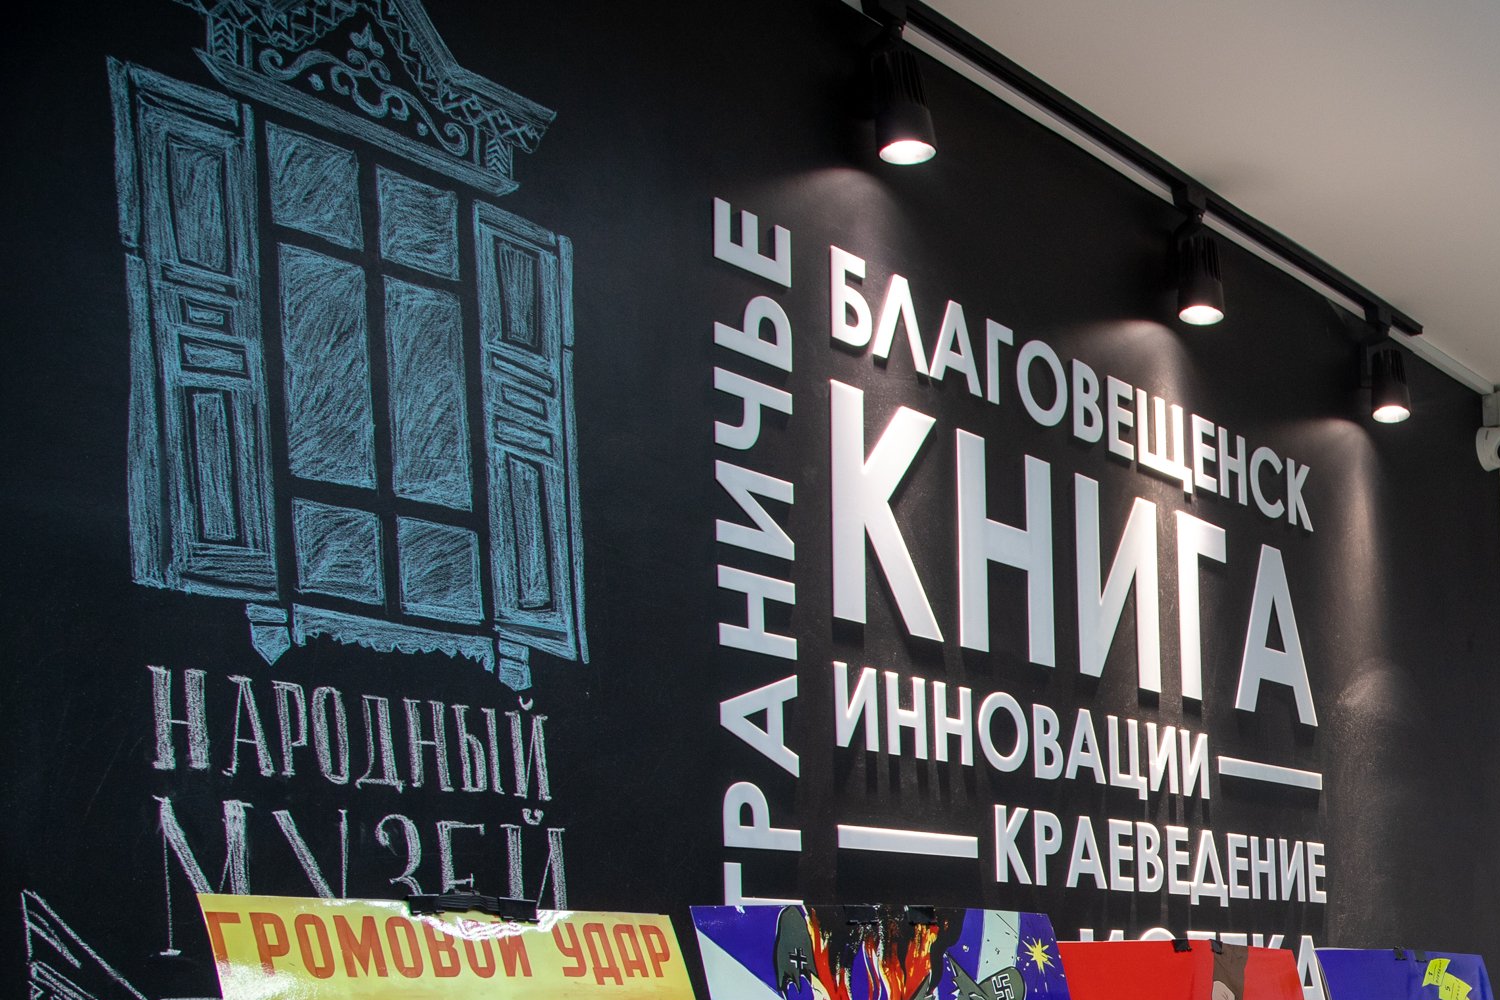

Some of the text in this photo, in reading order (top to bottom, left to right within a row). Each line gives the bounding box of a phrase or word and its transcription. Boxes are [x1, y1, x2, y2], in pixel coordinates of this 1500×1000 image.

[829, 244, 1314, 533] БЛАГОВЕЩЕНСК
[829, 378, 1318, 727] КНИГА
[146, 664, 552, 801] НАРОДНЫЙ
[832, 660, 1210, 800] ИННОВАЦИИ
[993, 803, 1328, 907] КРАЕВЕДЕНИЕ
[552, 920, 672, 986] УДАР
